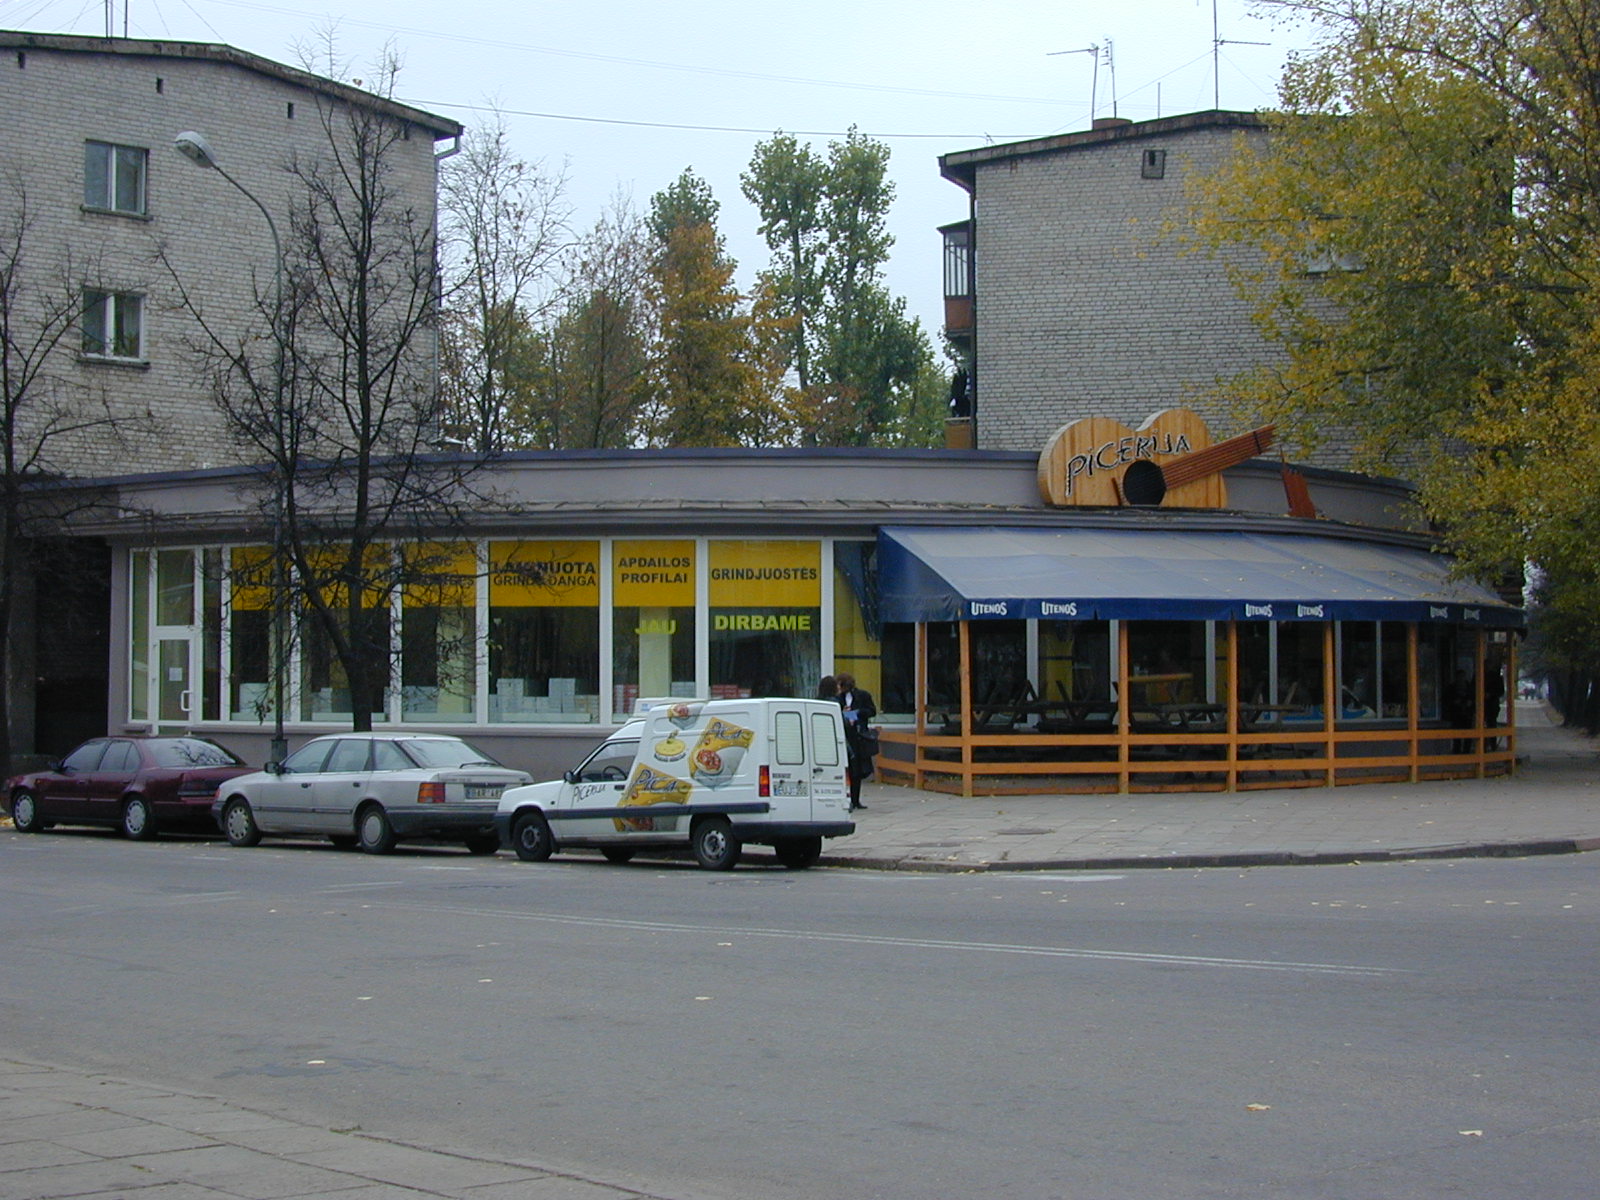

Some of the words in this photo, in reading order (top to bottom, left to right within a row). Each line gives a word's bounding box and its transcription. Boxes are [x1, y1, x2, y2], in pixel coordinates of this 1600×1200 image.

[493, 560, 596, 575] LANUOTA
[617, 557, 692, 569] APDAILOS
[493, 573, 545, 587] GRIND
[549, 573, 597, 587] DANGA
[621, 573, 688, 584] PROFILAI
[971, 601, 1008, 616] UTENOS
[1042, 601, 1078, 616] UTENOS
[635, 620, 677, 635] JAU
[714, 615, 811, 631] DIRBAME
